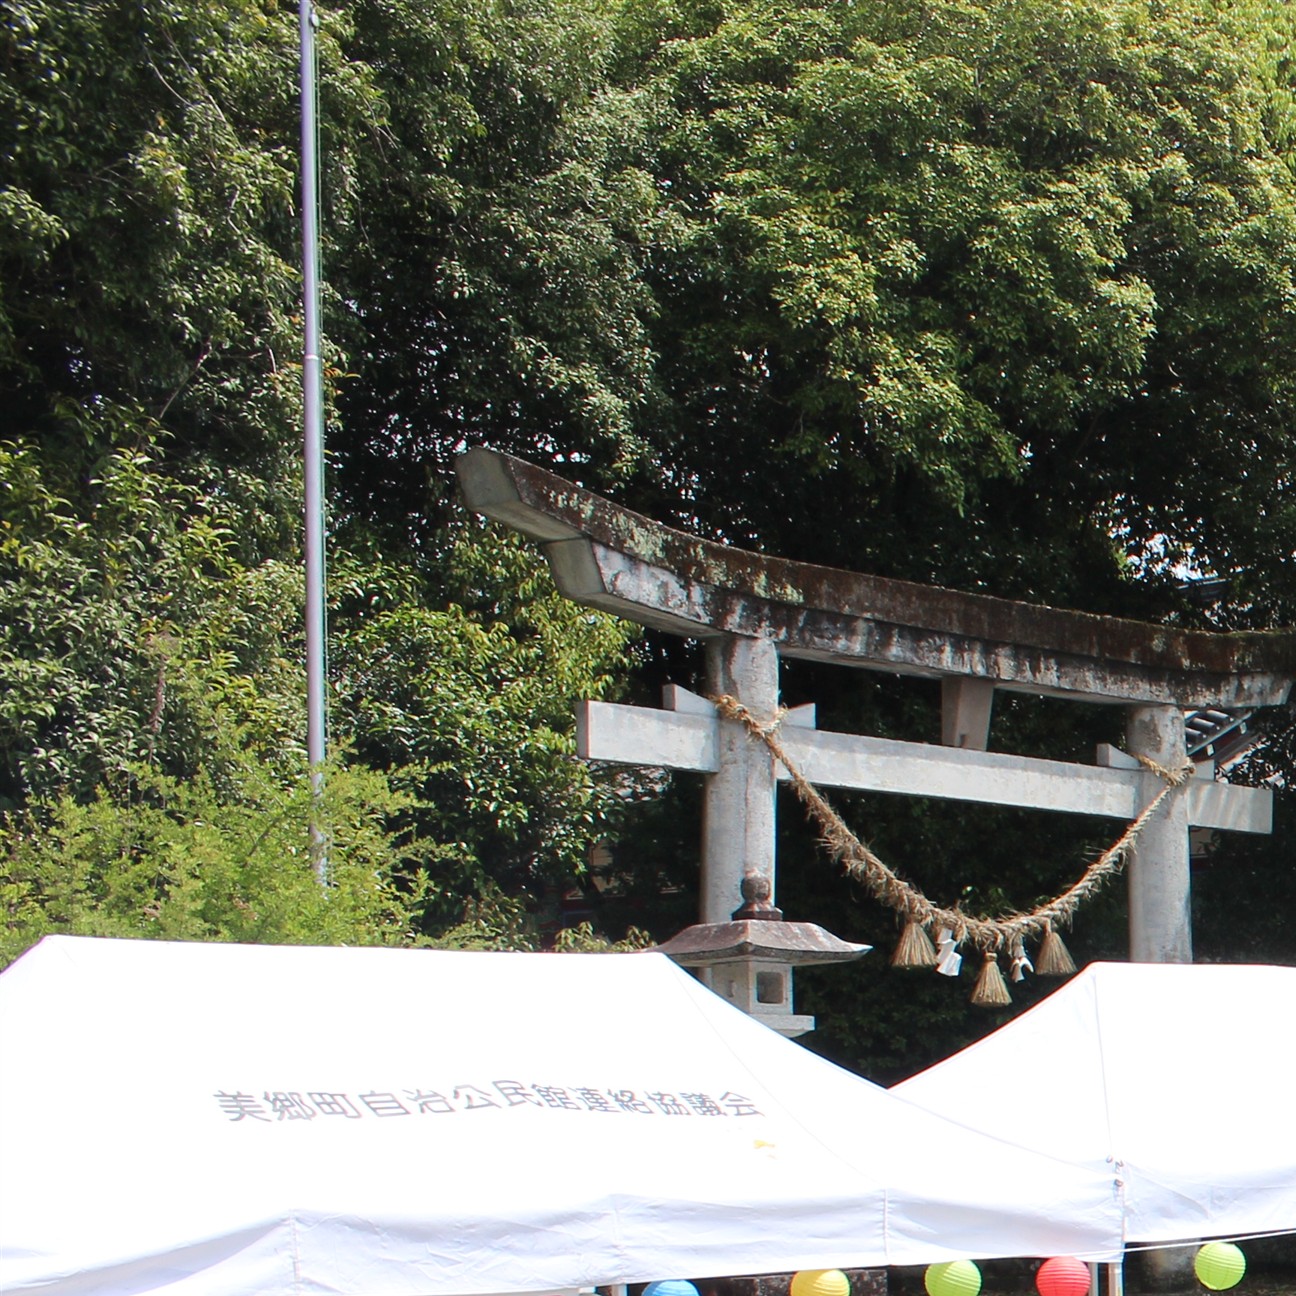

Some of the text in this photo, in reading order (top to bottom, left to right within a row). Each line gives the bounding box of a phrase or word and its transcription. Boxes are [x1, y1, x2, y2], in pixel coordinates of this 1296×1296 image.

[212, 1079, 766, 1122] 美郷町自治公民館連絡協議会
